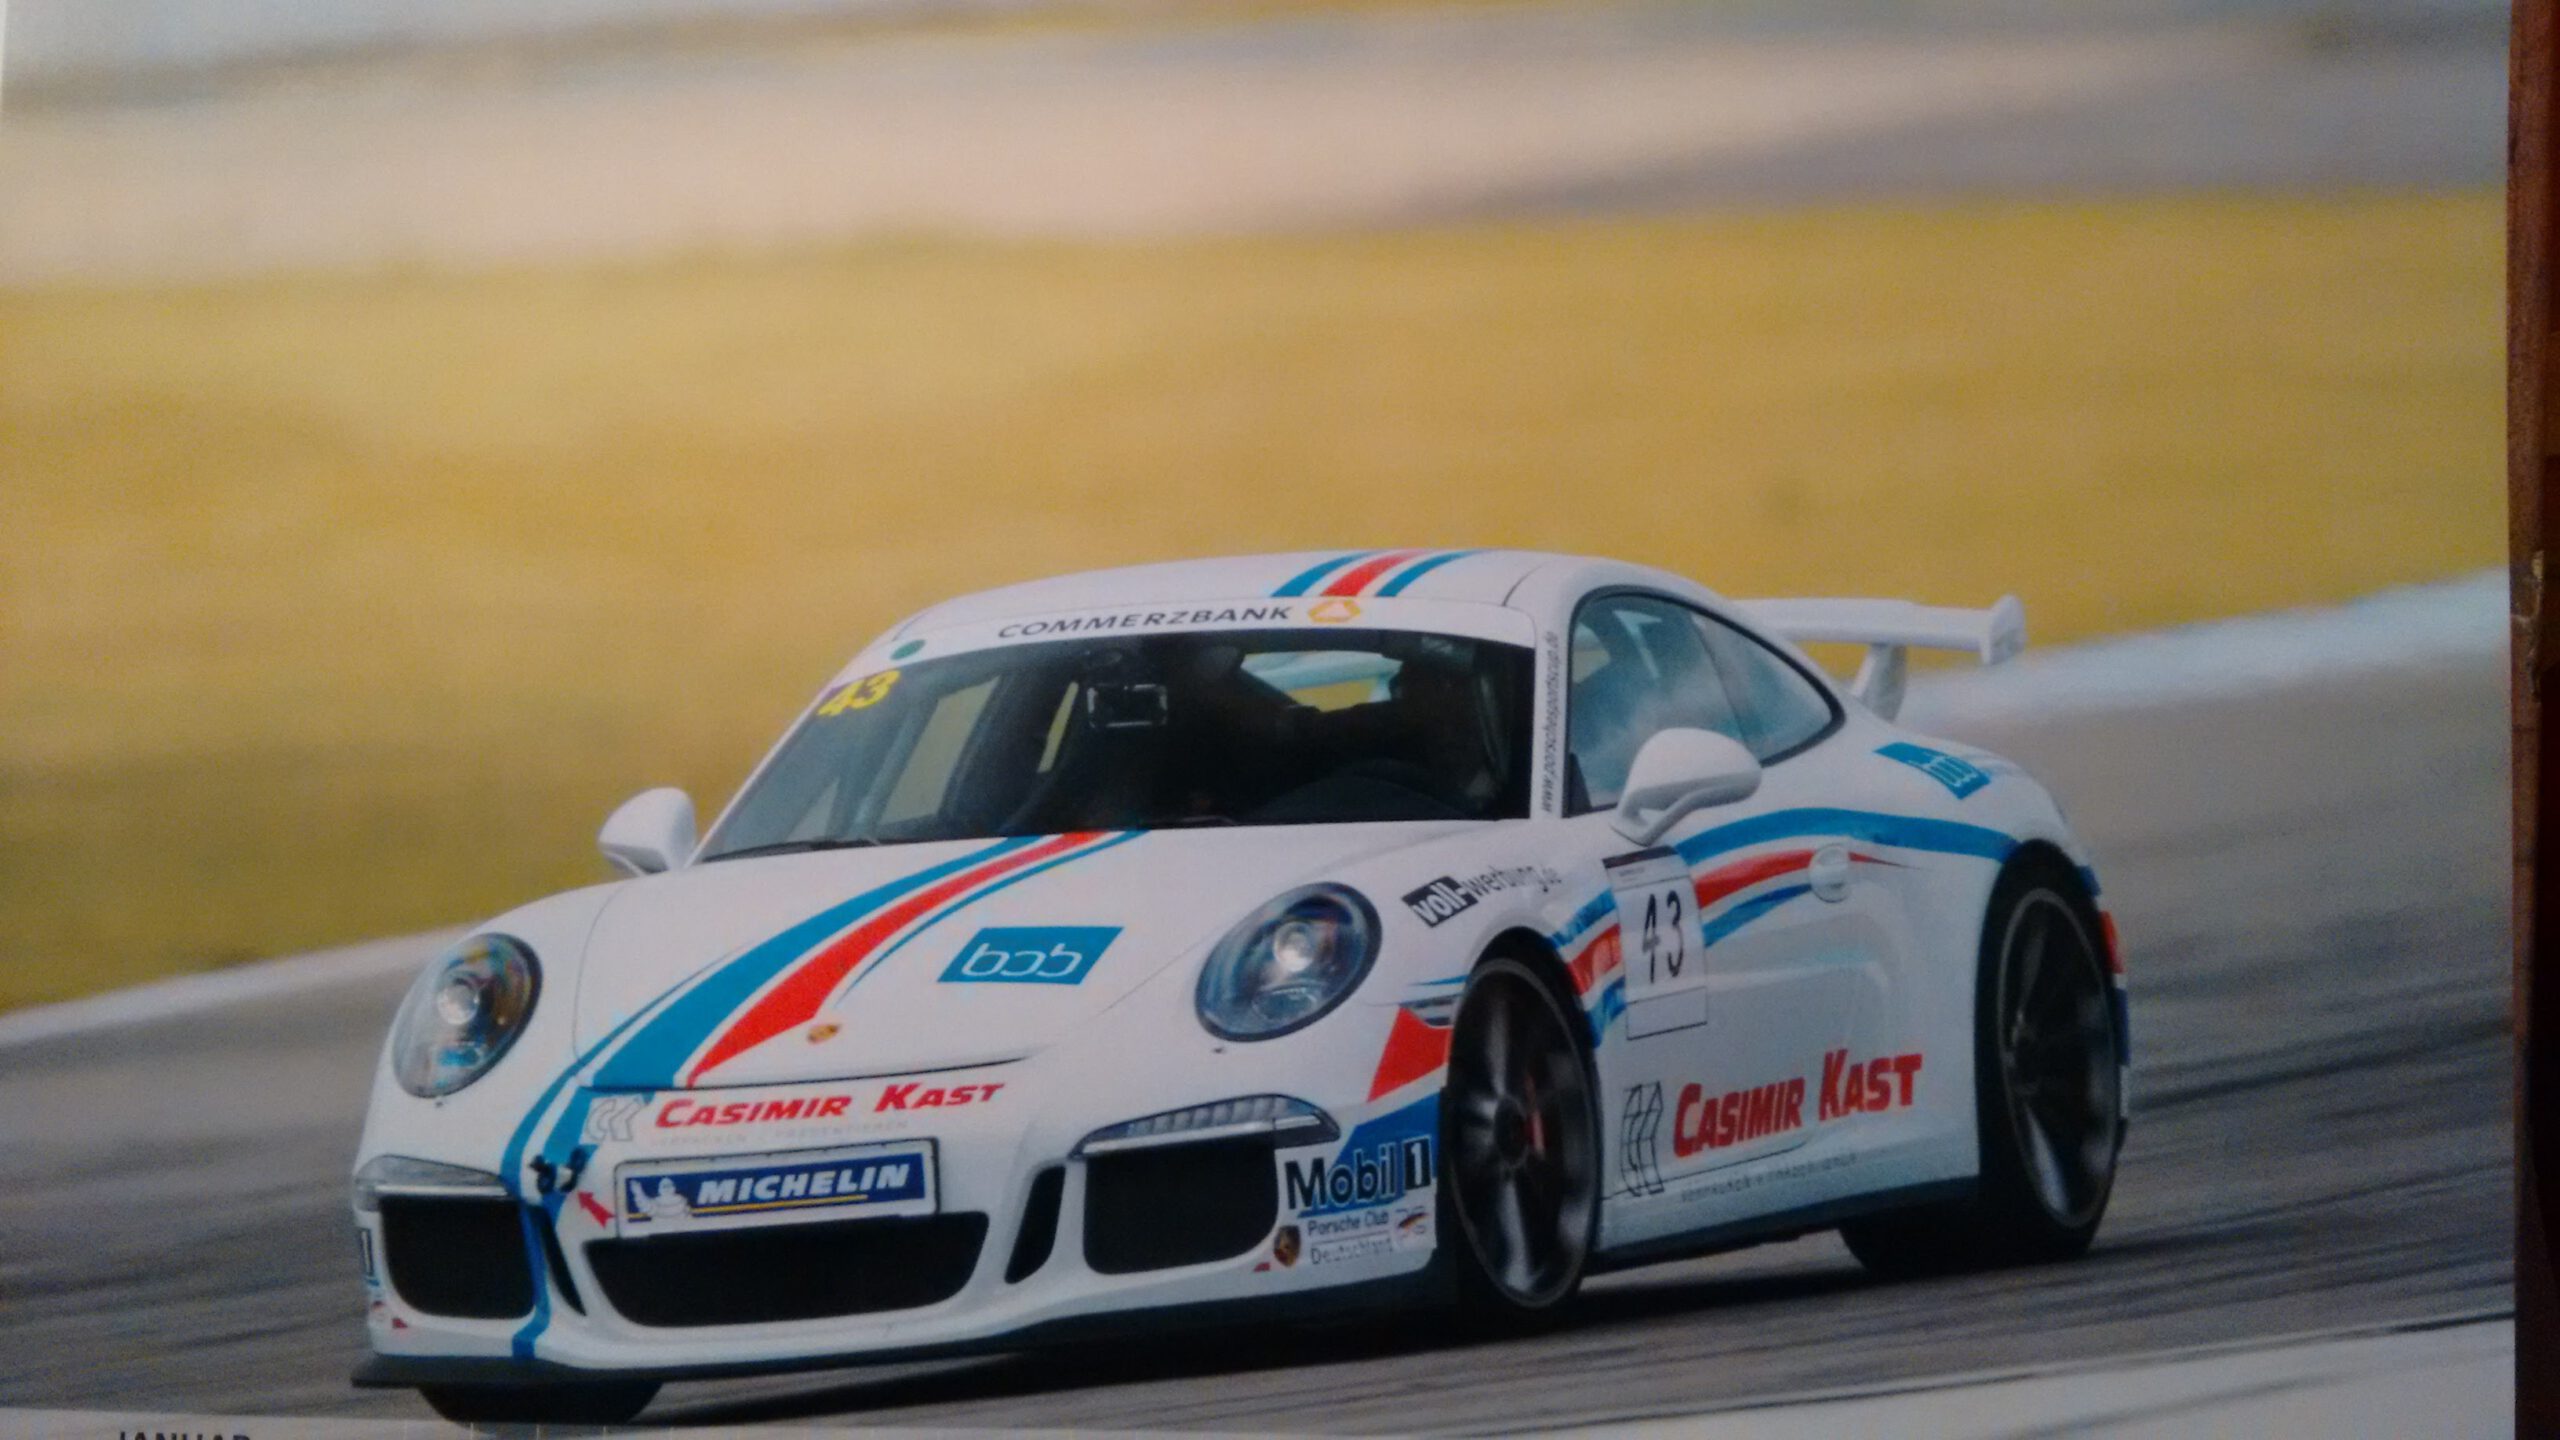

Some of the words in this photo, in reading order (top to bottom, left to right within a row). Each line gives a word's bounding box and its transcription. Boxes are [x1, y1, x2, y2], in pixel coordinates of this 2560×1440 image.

[997, 605, 1293, 640] COMMERZBANK
[817, 670, 901, 716] 43
[1642, 888, 1684, 983] 43
[655, 1095, 852, 1129] CASIMIR
[873, 1083, 1005, 1113] KAST
[1674, 1077, 1806, 1158] CASIMIR
[1818, 1048, 1923, 1122] KAST
[696, 1162, 911, 1205] MICHELIN
[1284, 1142, 1397, 1210] Mobil
[1402, 1135, 1431, 1190] 1
